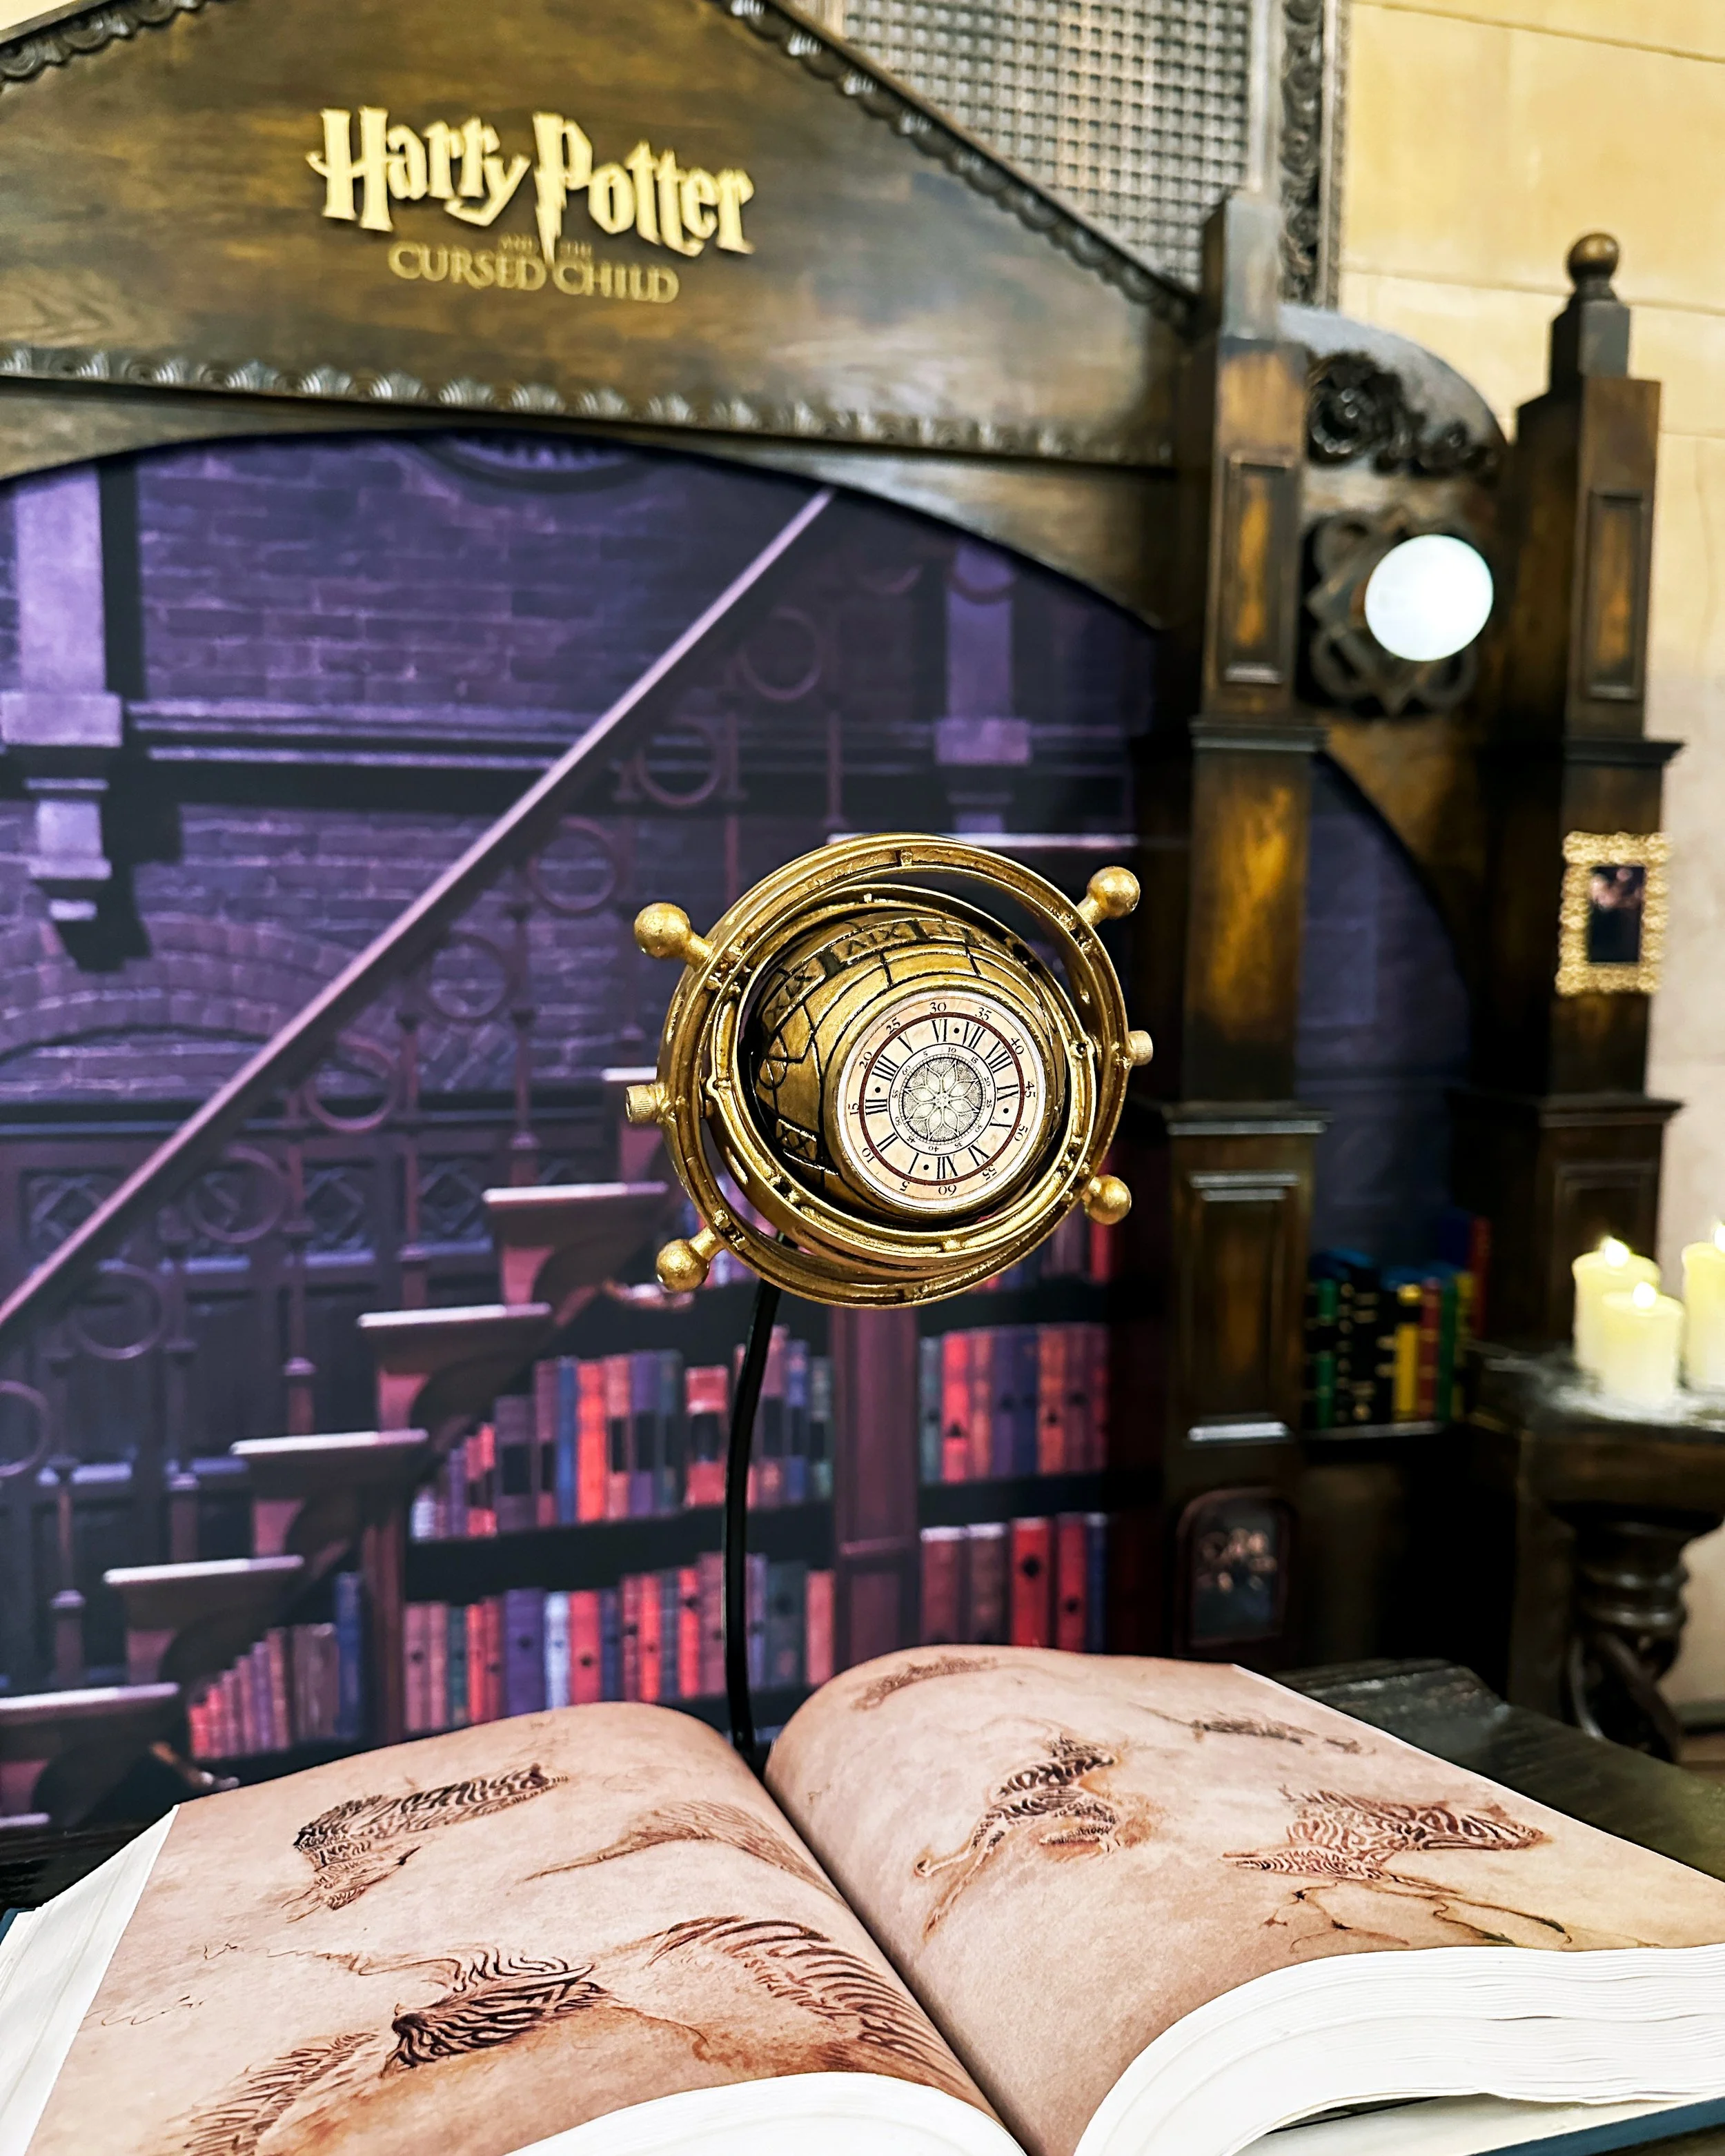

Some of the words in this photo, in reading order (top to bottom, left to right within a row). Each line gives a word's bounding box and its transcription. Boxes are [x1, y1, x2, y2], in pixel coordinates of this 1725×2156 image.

[305, 106, 531, 232] Harry
[533, 111, 755, 265] Potter
[388, 241, 546, 292] CURSED
[553, 258, 680, 304] CHILD
[929, 1002, 947, 1012] 30
[975, 1007, 992, 1021] 35
[887, 1018, 900, 1034] 25
[931, 1019, 947, 1042] VI
[897, 1032, 914, 1053] V
[962, 1022, 986, 1049] VII
[1010, 1037, 1025, 1055] 40
[859, 1051, 873, 1069] 20
[985, 1040, 1013, 1074] VIII
[871, 1054, 899, 1081] IIII
[903, 1065, 911, 1076] 60
[984, 1077, 990, 1087] 20
[1025, 1080, 1036, 1098] 45
[997, 1084, 1019, 1101] IX
[849, 1104, 860, 1115] 15
[865, 1099, 887, 1116] III
[986, 1100, 992, 1108] 25
[895, 1116, 902, 1126] 50
[975, 1125, 983, 1133] 30
[990, 1117, 1012, 1132] X
[876, 1132, 898, 1153] II
[1014, 1126, 1028, 1142] 50
[862, 1147, 876, 1164] 10
[968, 1140, 990, 1167] XI
[908, 1153, 919, 1174] I
[936, 1154, 958, 1179] XII
[982, 1164, 997, 1181] 55
[899, 1181, 910, 1191] 5
[938, 1185, 956, 1196] 60
